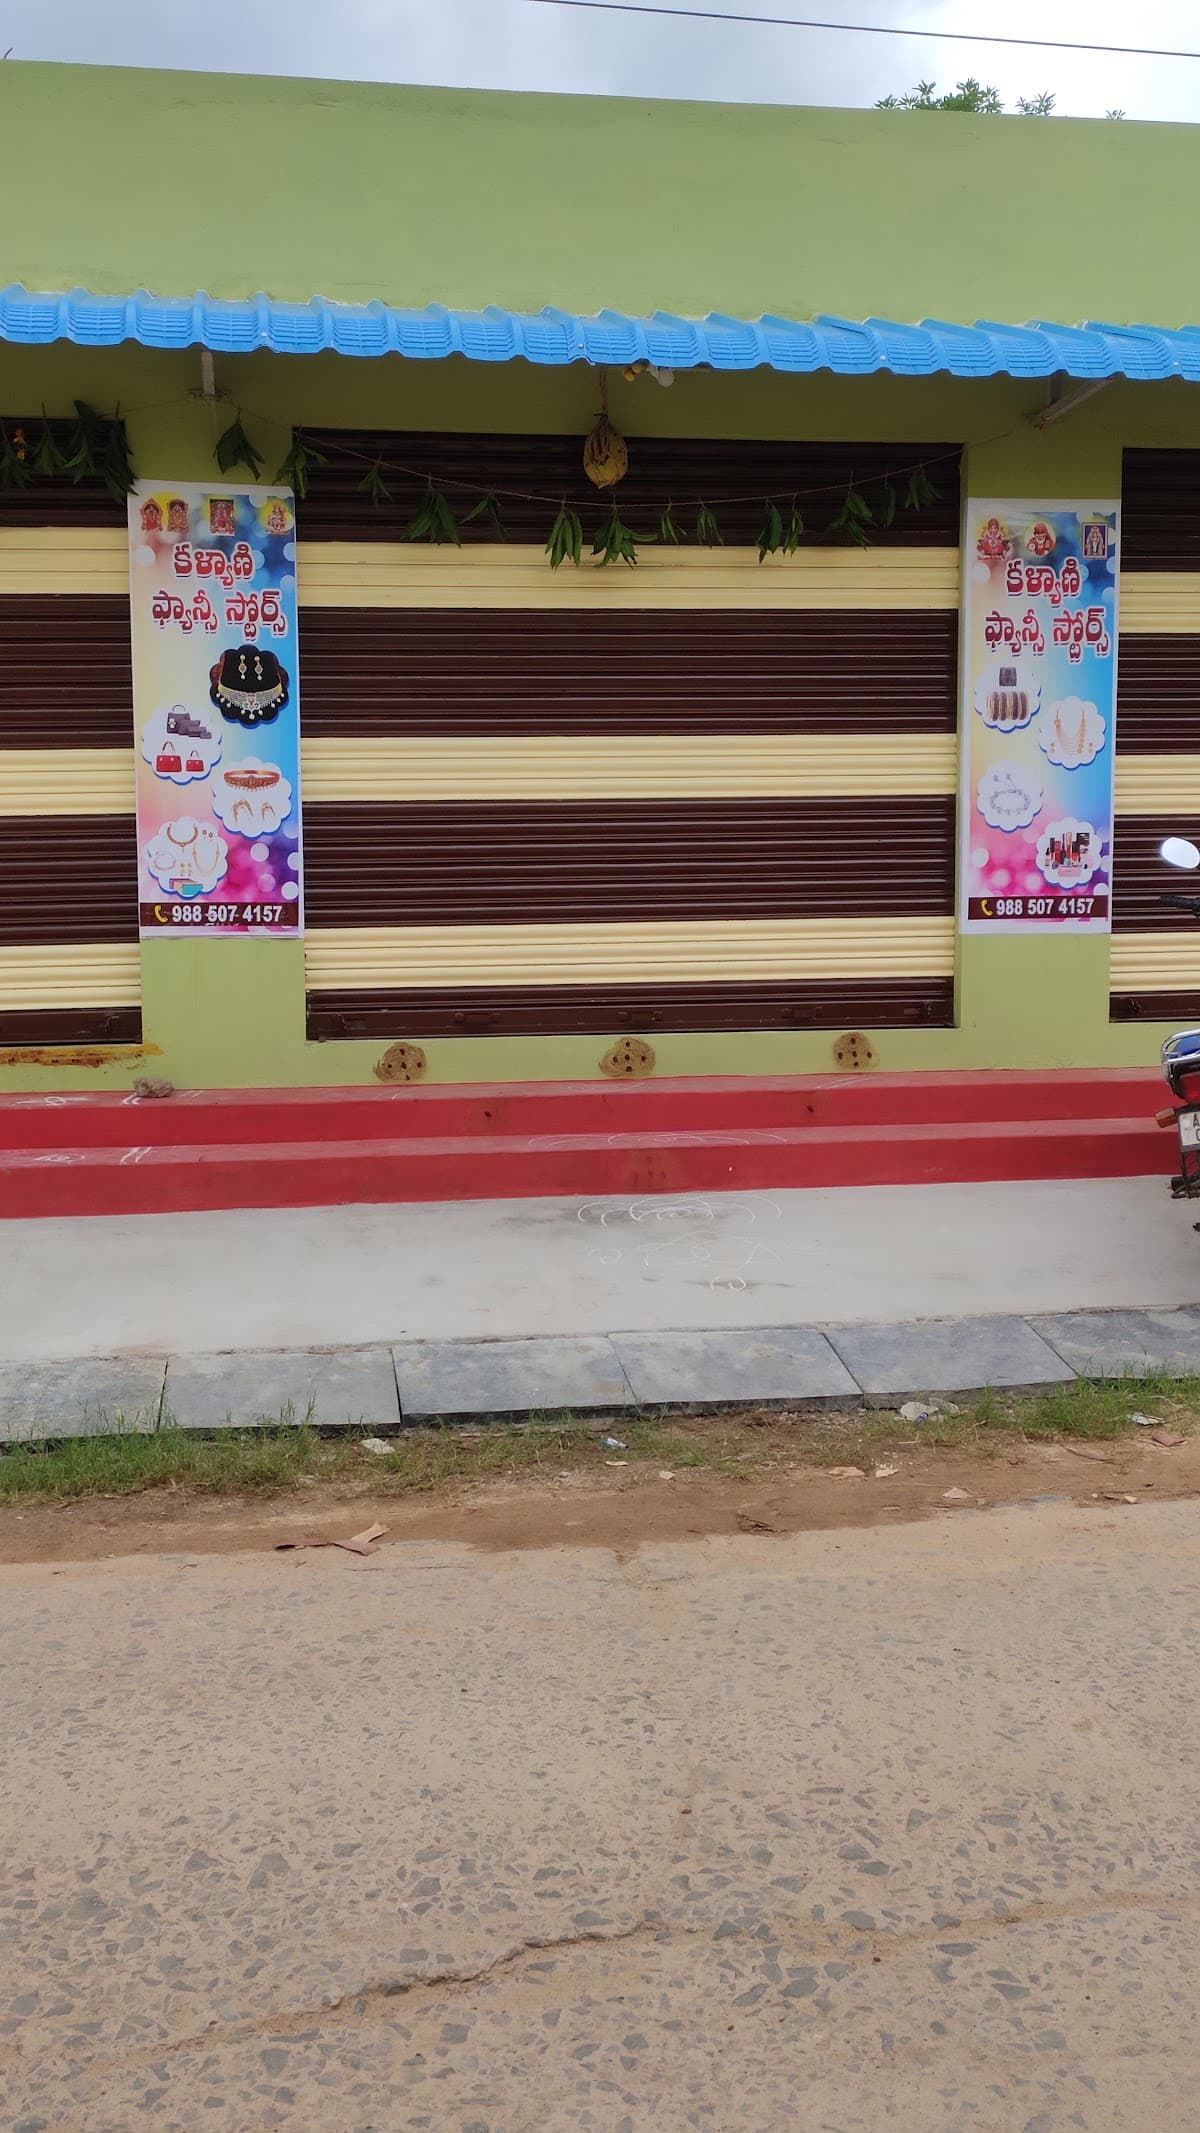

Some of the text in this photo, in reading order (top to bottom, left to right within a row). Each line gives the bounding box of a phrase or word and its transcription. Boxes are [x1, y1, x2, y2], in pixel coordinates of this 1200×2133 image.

[172, 905, 283, 922] 988 507 4157
[996, 898, 1095, 916] 988 507 4157
